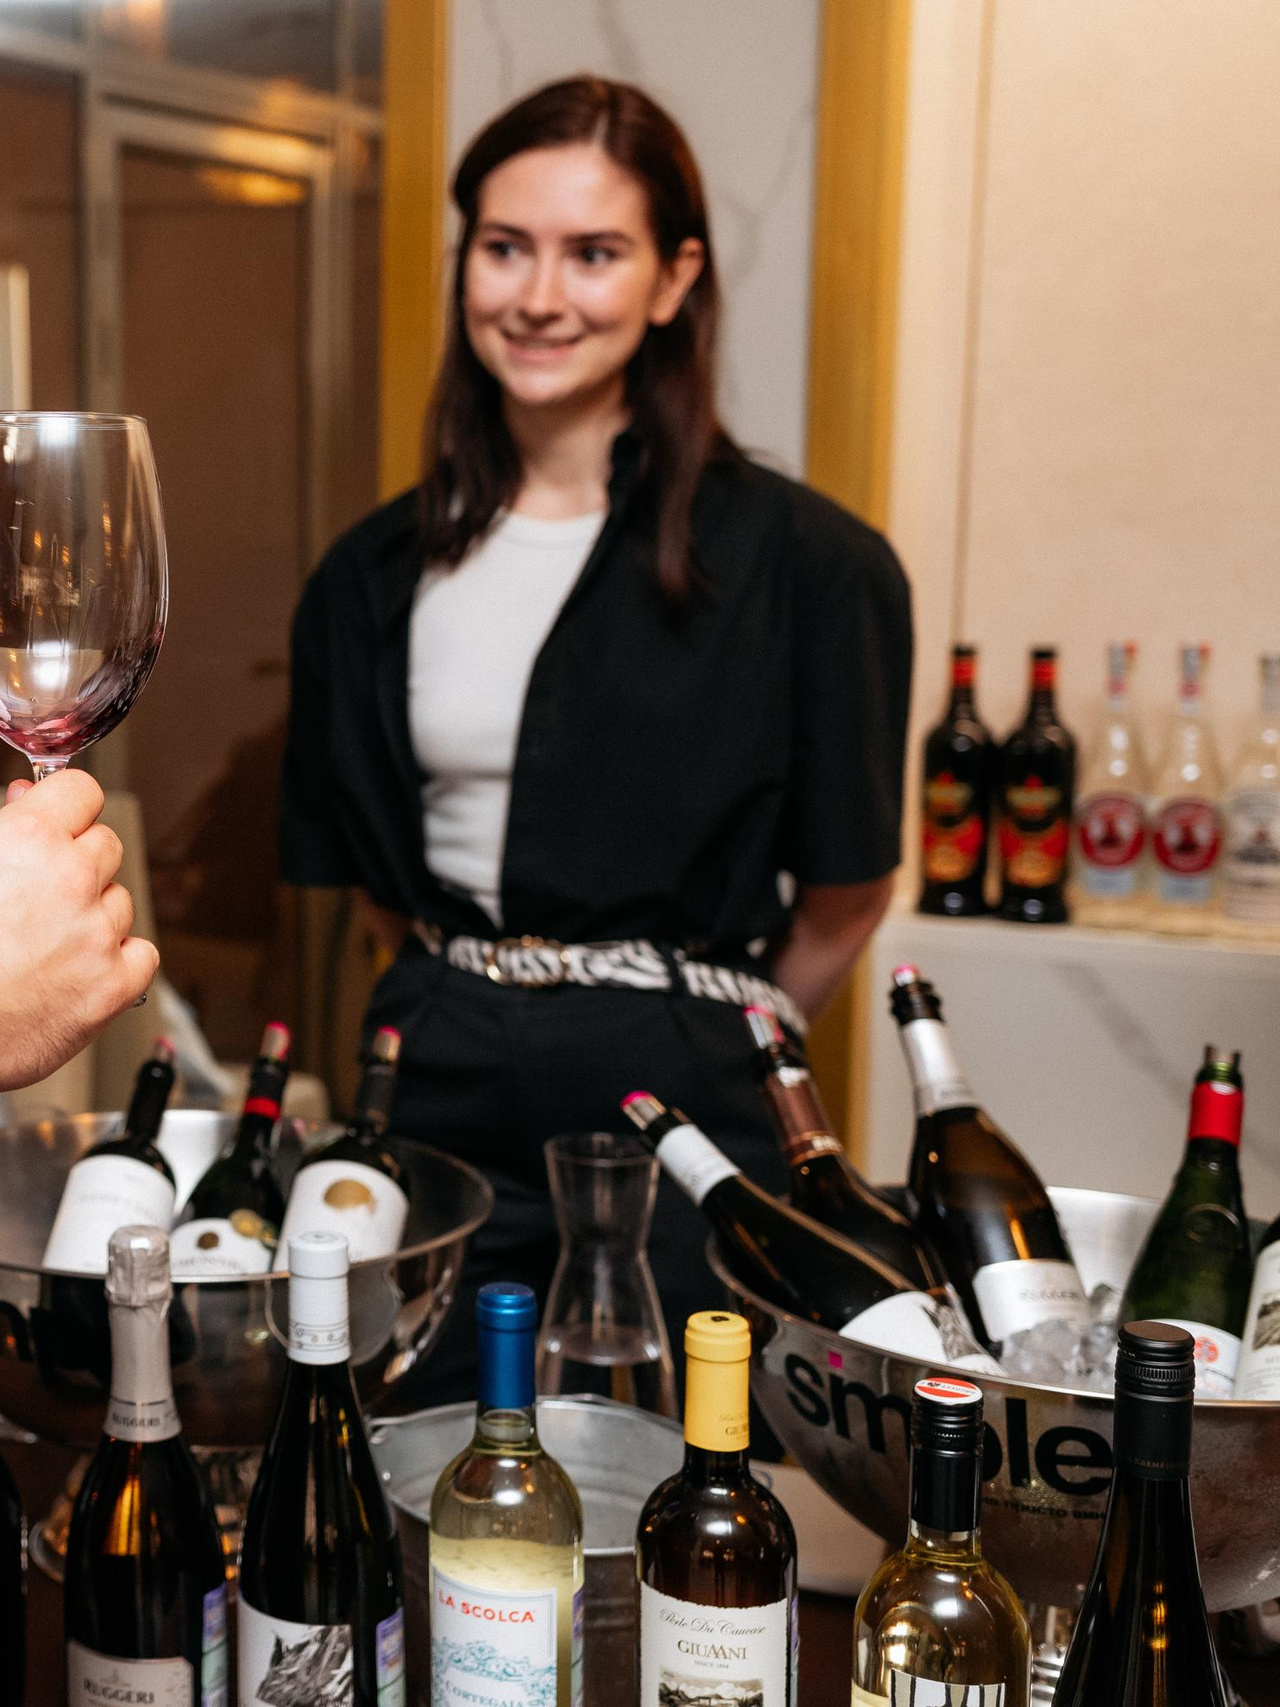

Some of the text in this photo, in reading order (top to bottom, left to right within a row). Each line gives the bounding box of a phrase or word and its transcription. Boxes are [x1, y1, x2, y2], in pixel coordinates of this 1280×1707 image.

[784, 1350, 1114, 1496] simle
[438, 1588, 535, 1623] LA SCOLCA
[690, 1616, 714, 1634] Du
